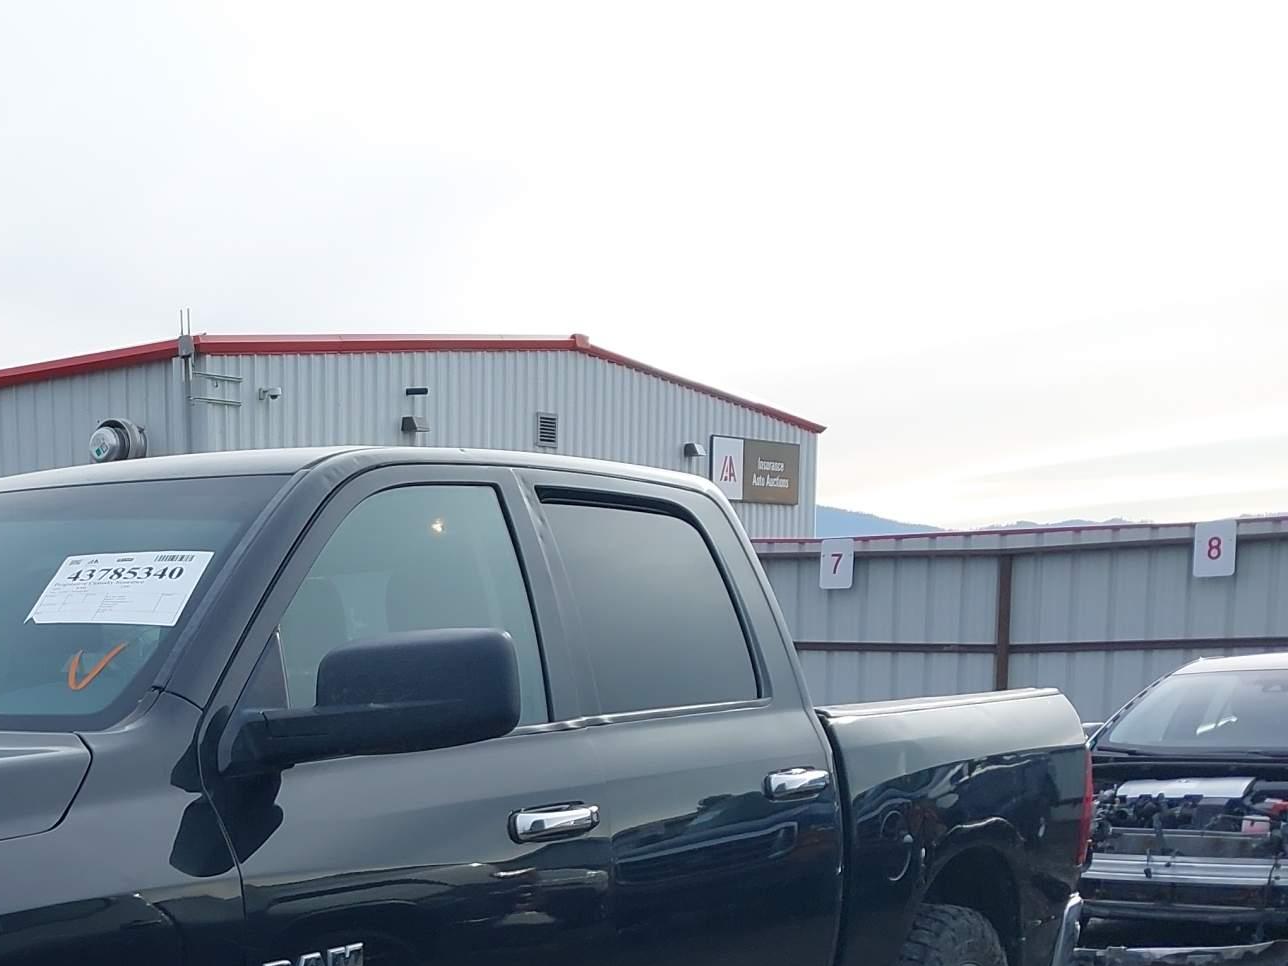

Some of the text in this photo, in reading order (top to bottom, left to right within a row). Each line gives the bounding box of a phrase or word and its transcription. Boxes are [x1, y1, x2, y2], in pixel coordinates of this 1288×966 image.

[757, 457, 784, 472] Insurance
[752, 473, 789, 488] Auto Auctions
[1206, 536, 1222, 560] 8
[831, 553, 843, 575] 7
[67, 566, 184, 582] 43785340
